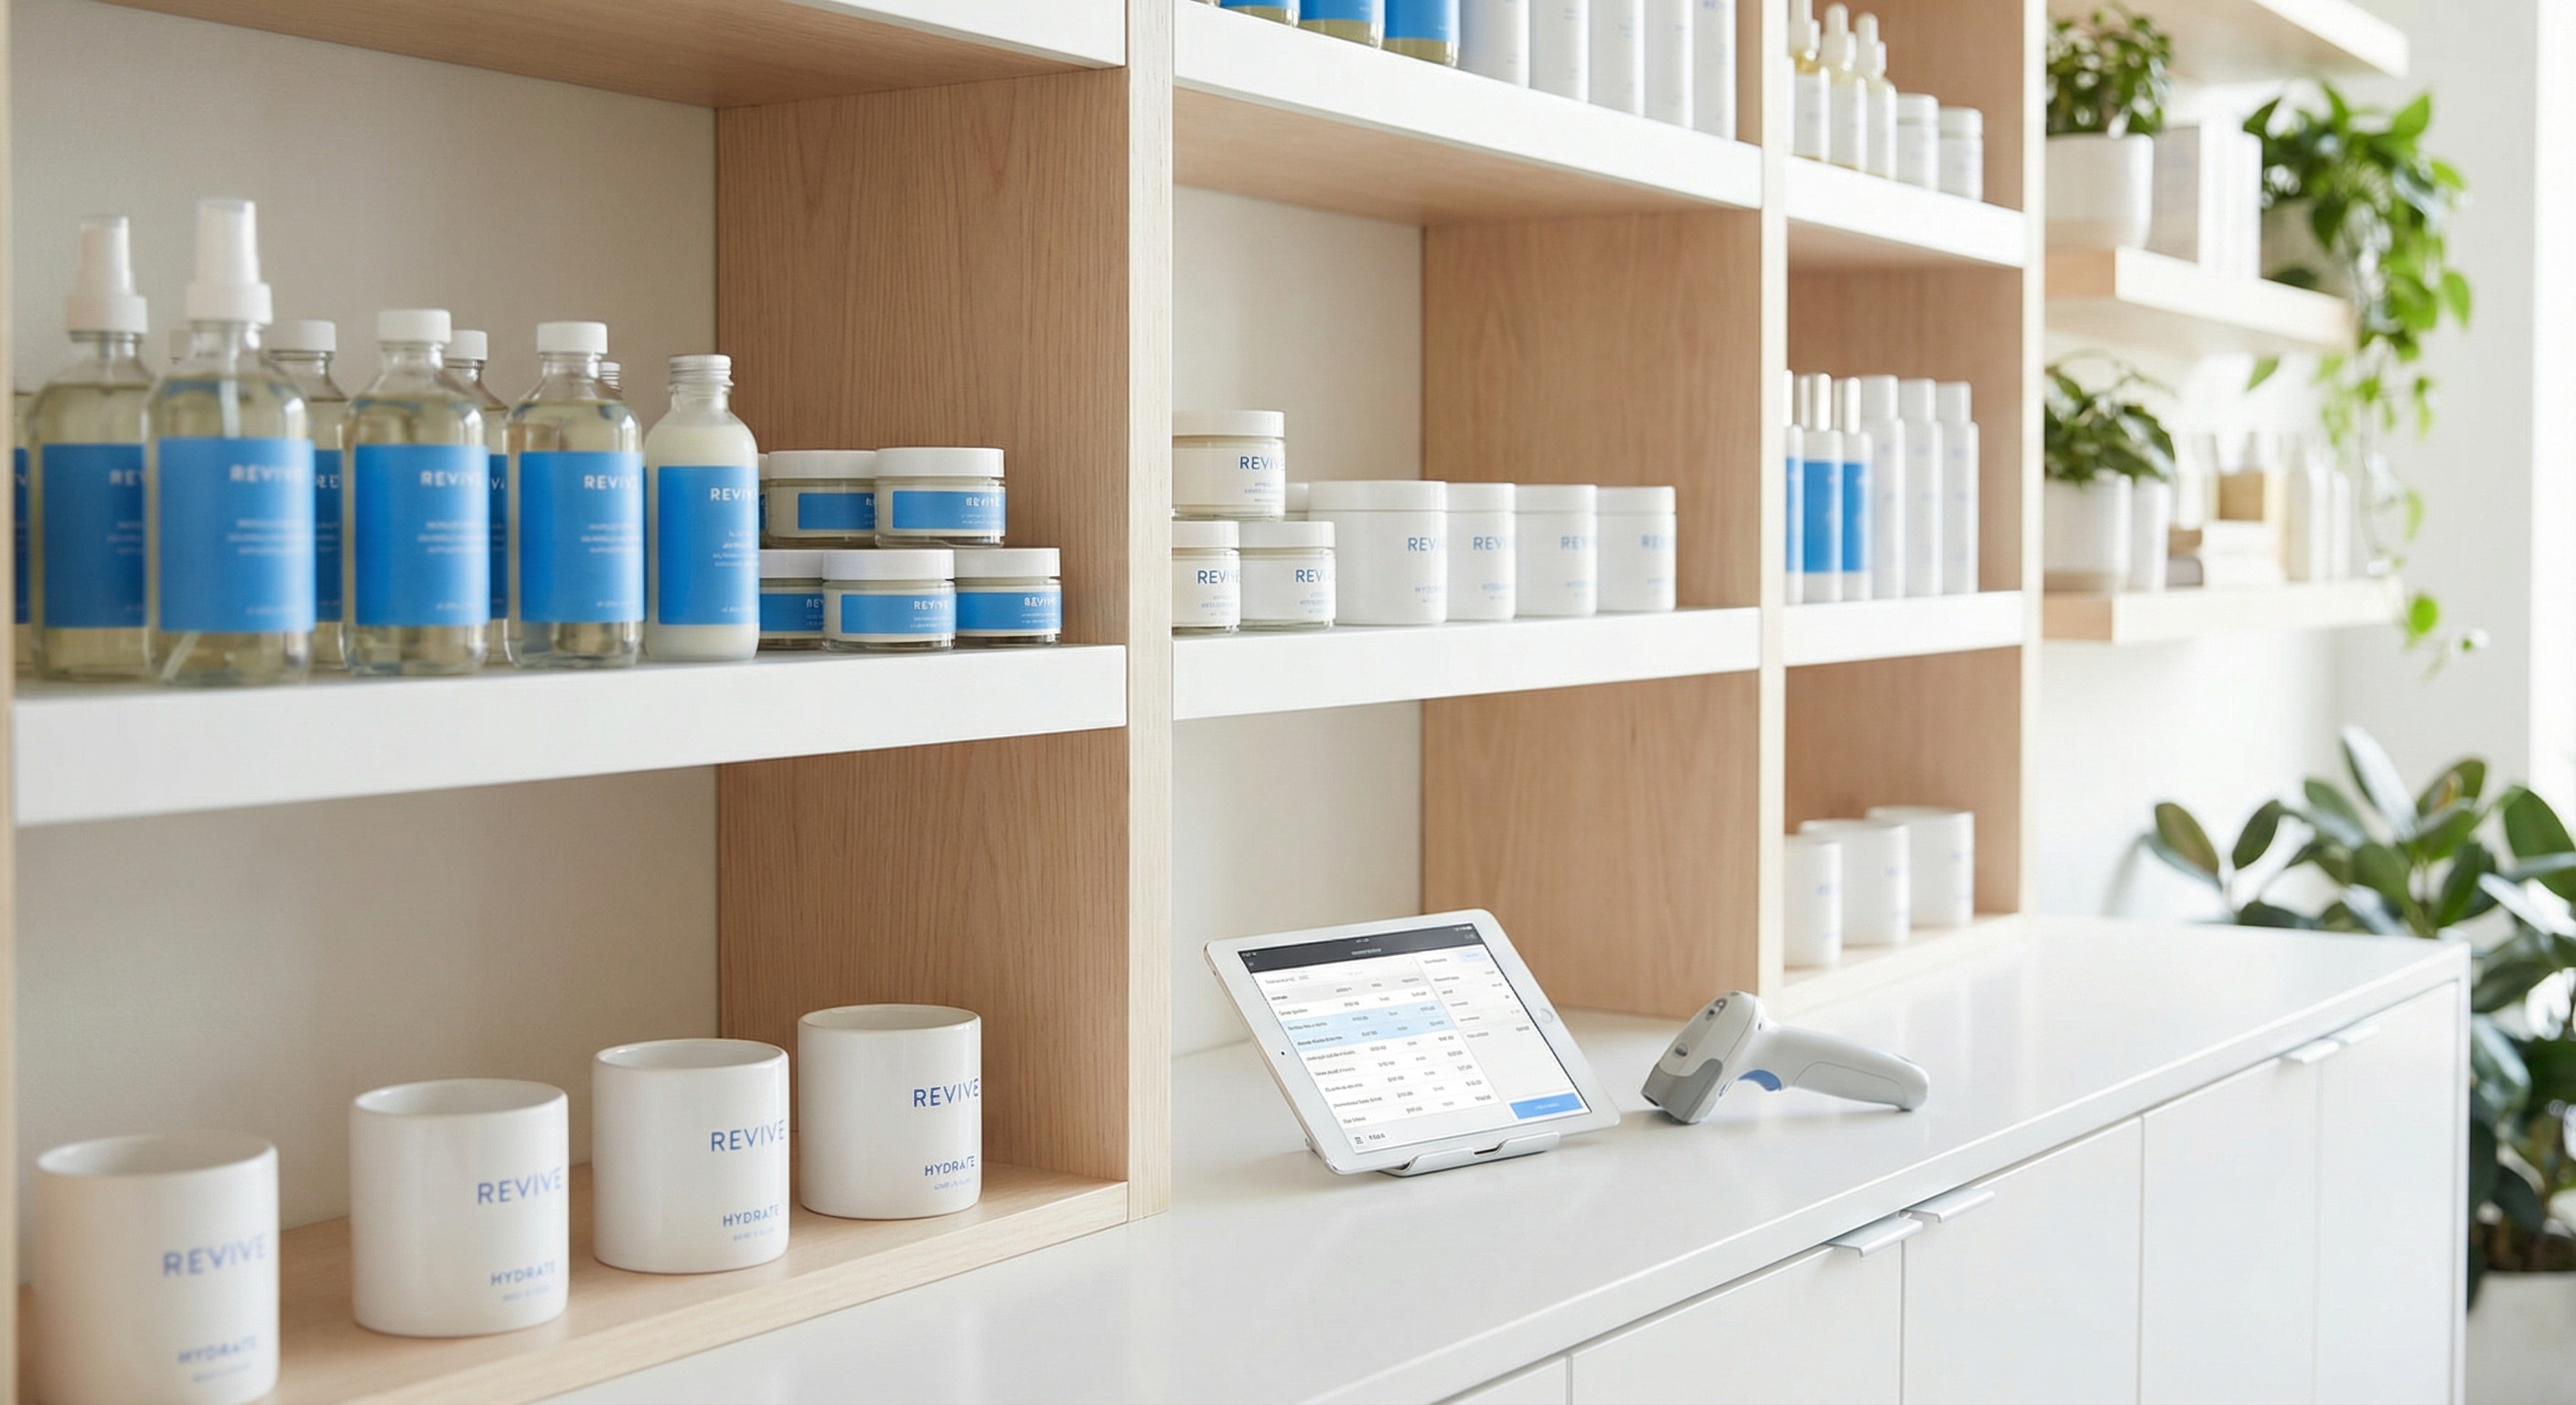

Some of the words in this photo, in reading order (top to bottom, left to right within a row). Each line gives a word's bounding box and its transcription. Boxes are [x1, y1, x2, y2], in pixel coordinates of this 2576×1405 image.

[914, 1078, 979, 1108] REVIVE
[711, 1119, 785, 1152] REVIVE
[924, 1154, 975, 1176] HYDRATE
[478, 1165, 562, 1205] REVIVE
[723, 1204, 779, 1227] HYDRATE
[163, 1233, 265, 1277] REVIVE
[491, 1260, 556, 1285] HYDRATE
